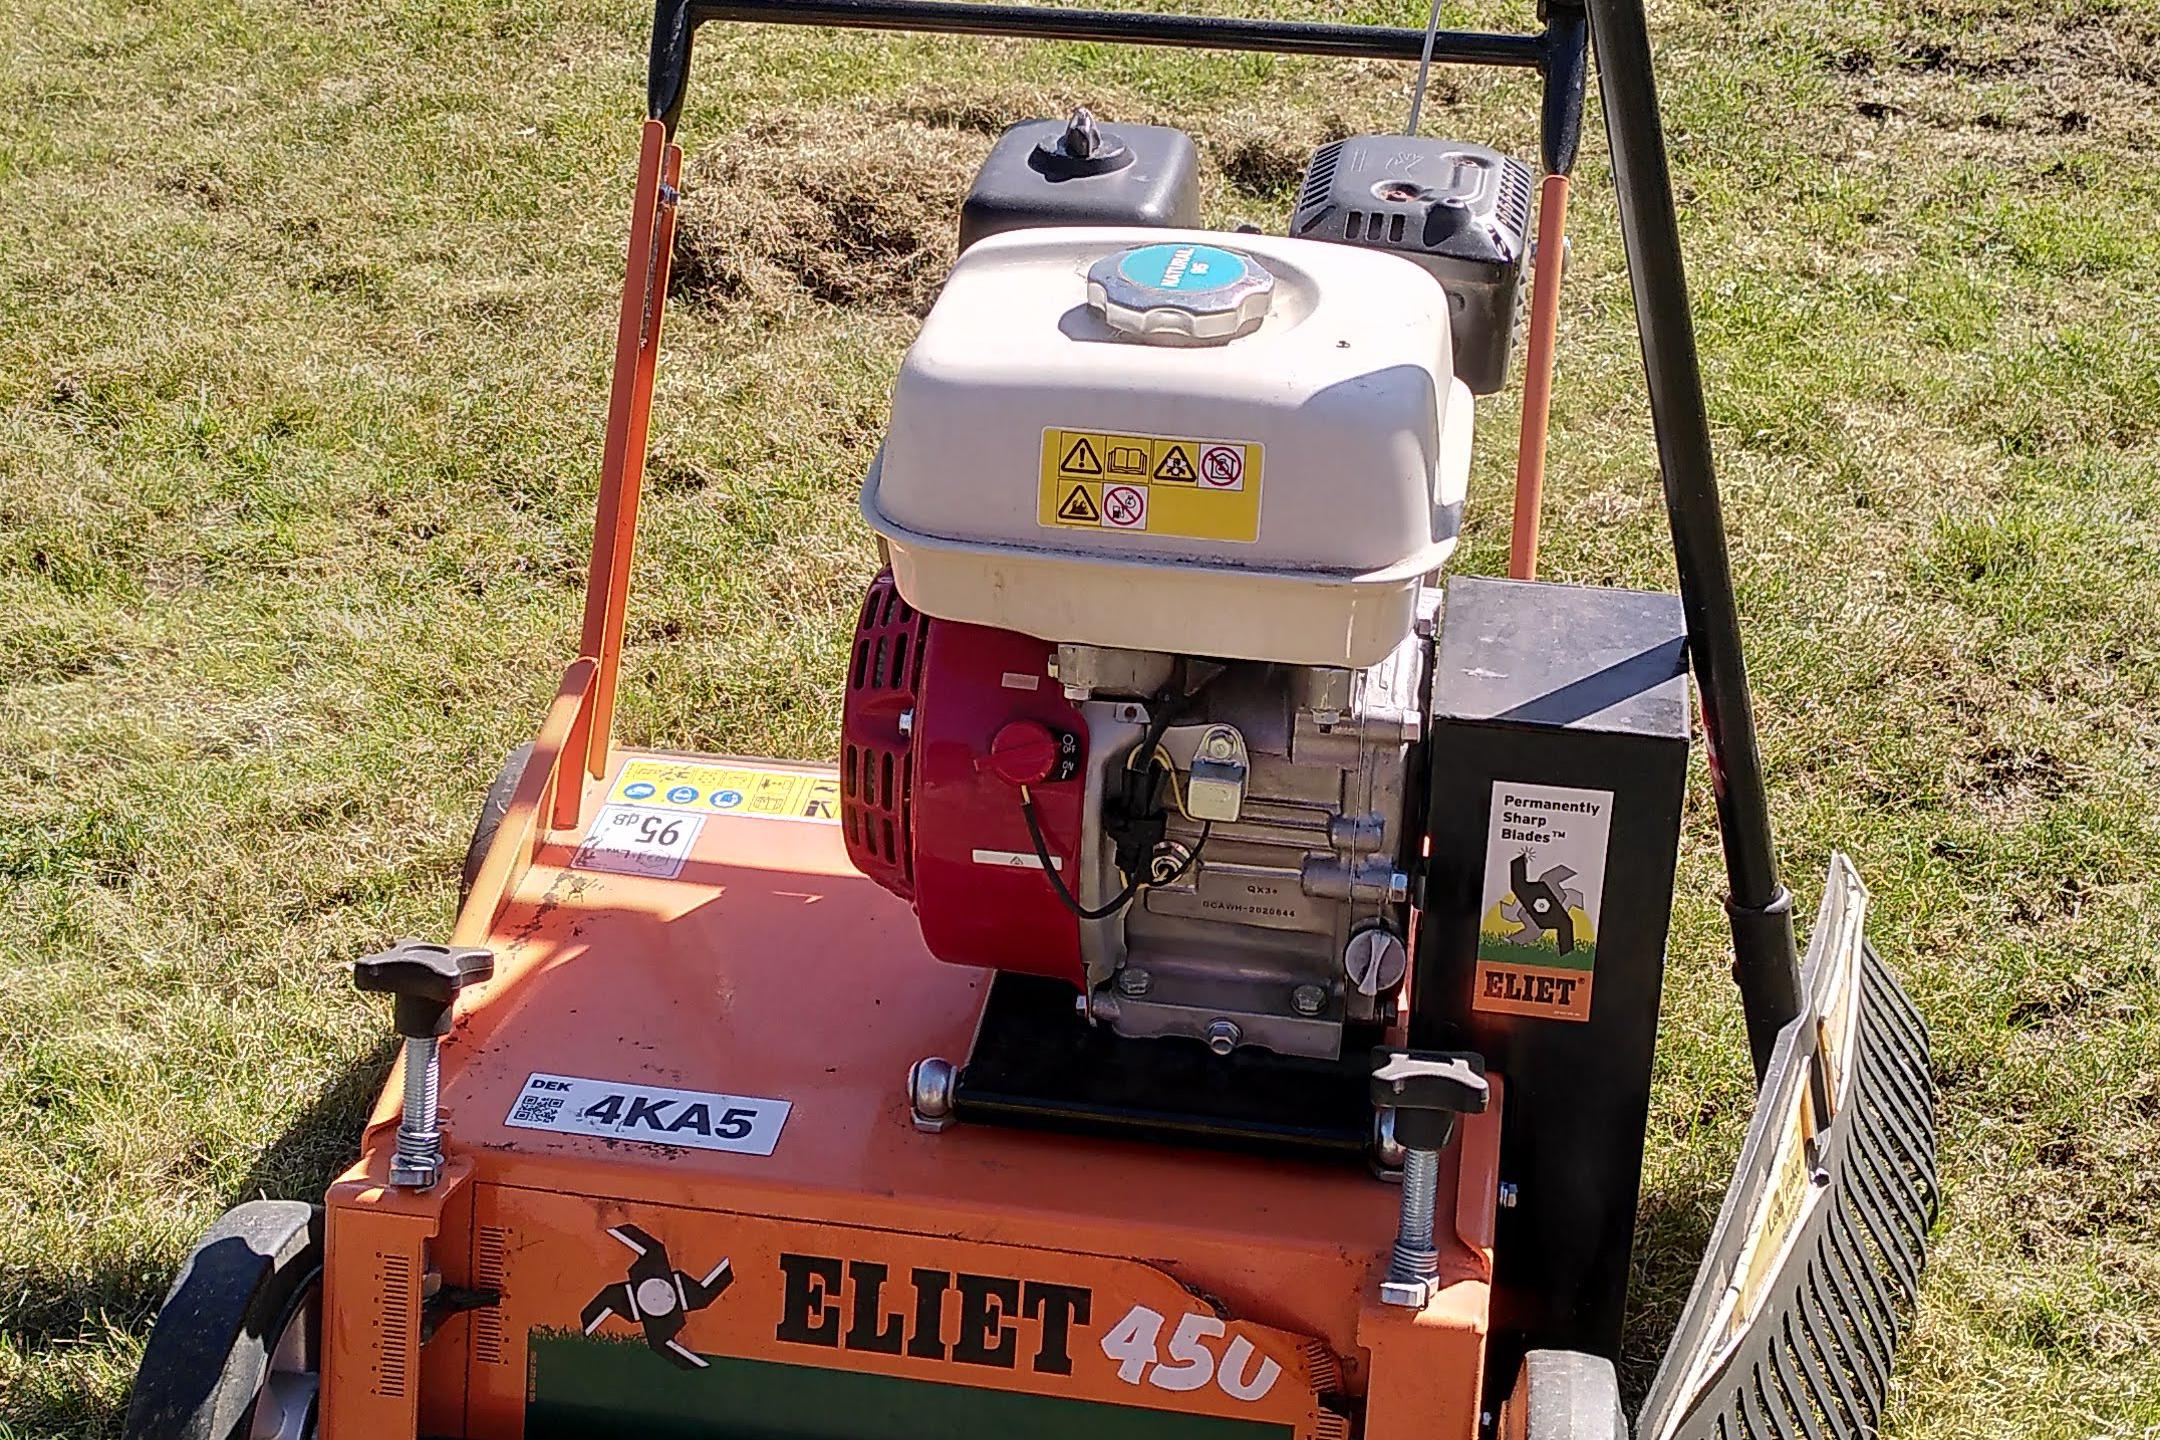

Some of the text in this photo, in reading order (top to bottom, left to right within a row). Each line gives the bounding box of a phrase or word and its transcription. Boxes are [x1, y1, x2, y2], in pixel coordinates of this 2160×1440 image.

[1159, 247, 1196, 288] NATURAL
[1062, 744, 1076, 754] OFF
[1062, 760, 1074, 771] ON
[1503, 795, 1600, 816] Permanently
[612, 812, 683, 846] 95 dB
[1502, 811, 1547, 828] Sharp
[530, 1079, 573, 1092] DEK
[584, 1095, 758, 1140] 4KA5
[775, 1252, 1092, 1376] ELIET
